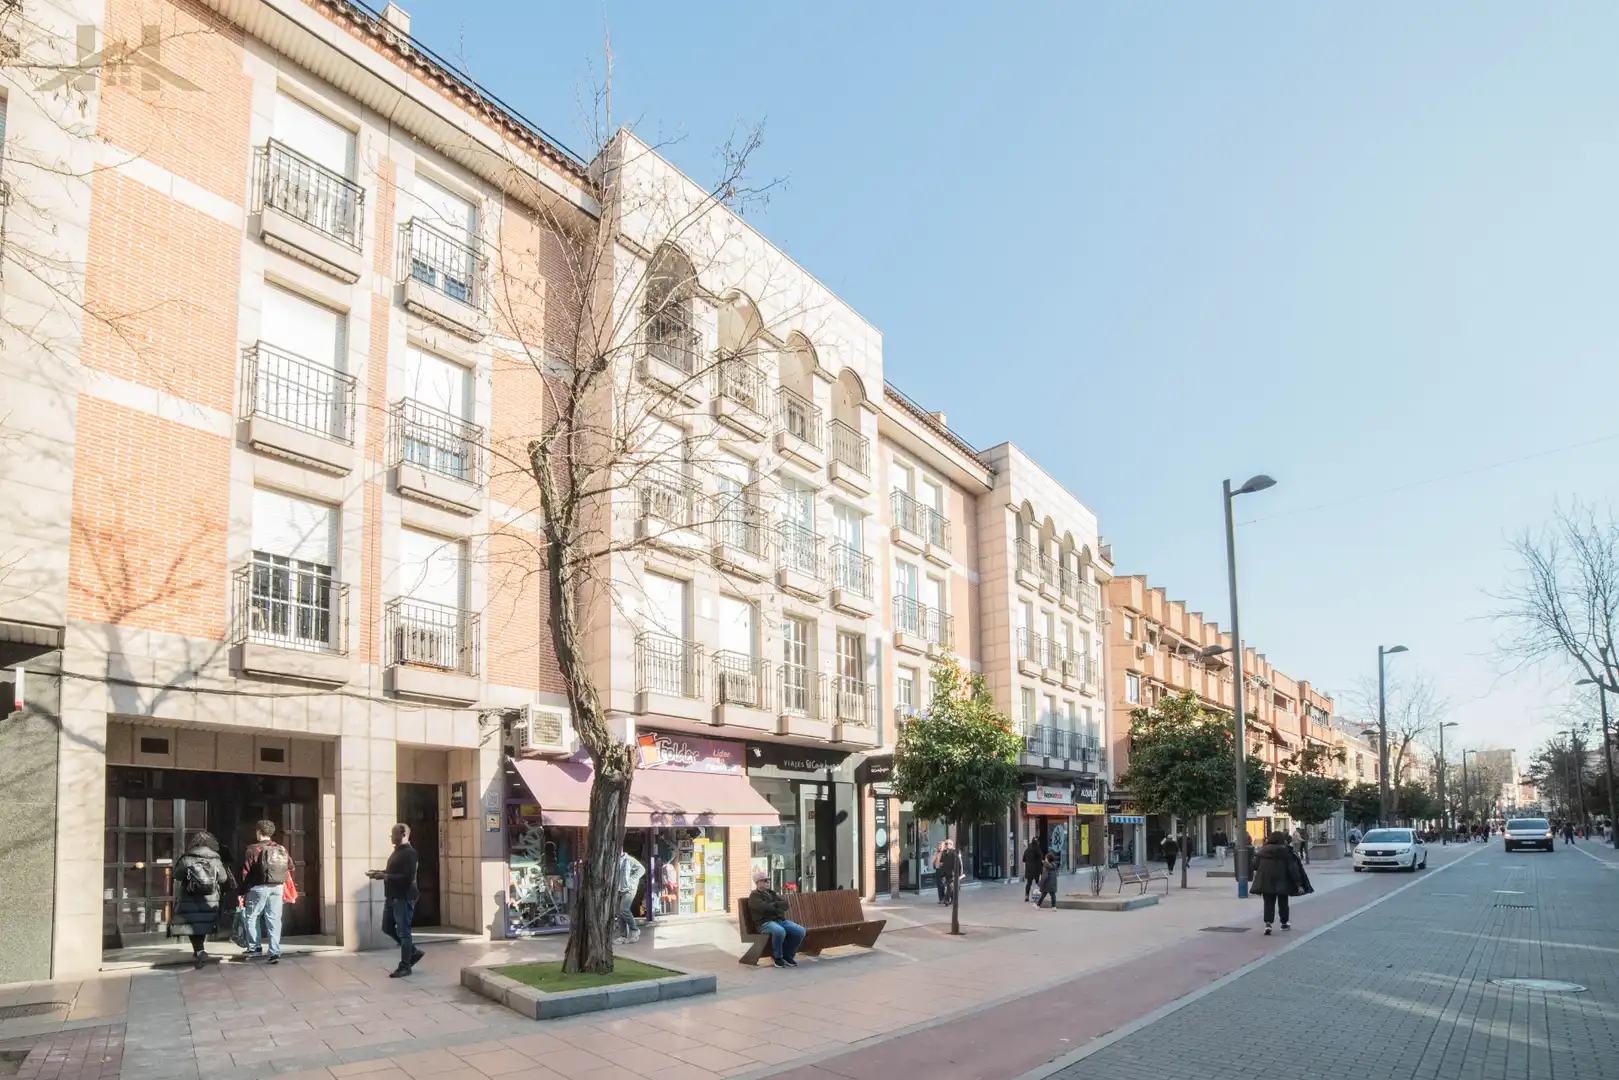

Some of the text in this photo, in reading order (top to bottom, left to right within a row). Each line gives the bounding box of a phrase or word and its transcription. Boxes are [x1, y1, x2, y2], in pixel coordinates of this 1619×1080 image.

[657, 737, 700, 764] Folder
[713, 749, 731, 758] Líder
[783, 760, 804, 768] VIAJES
